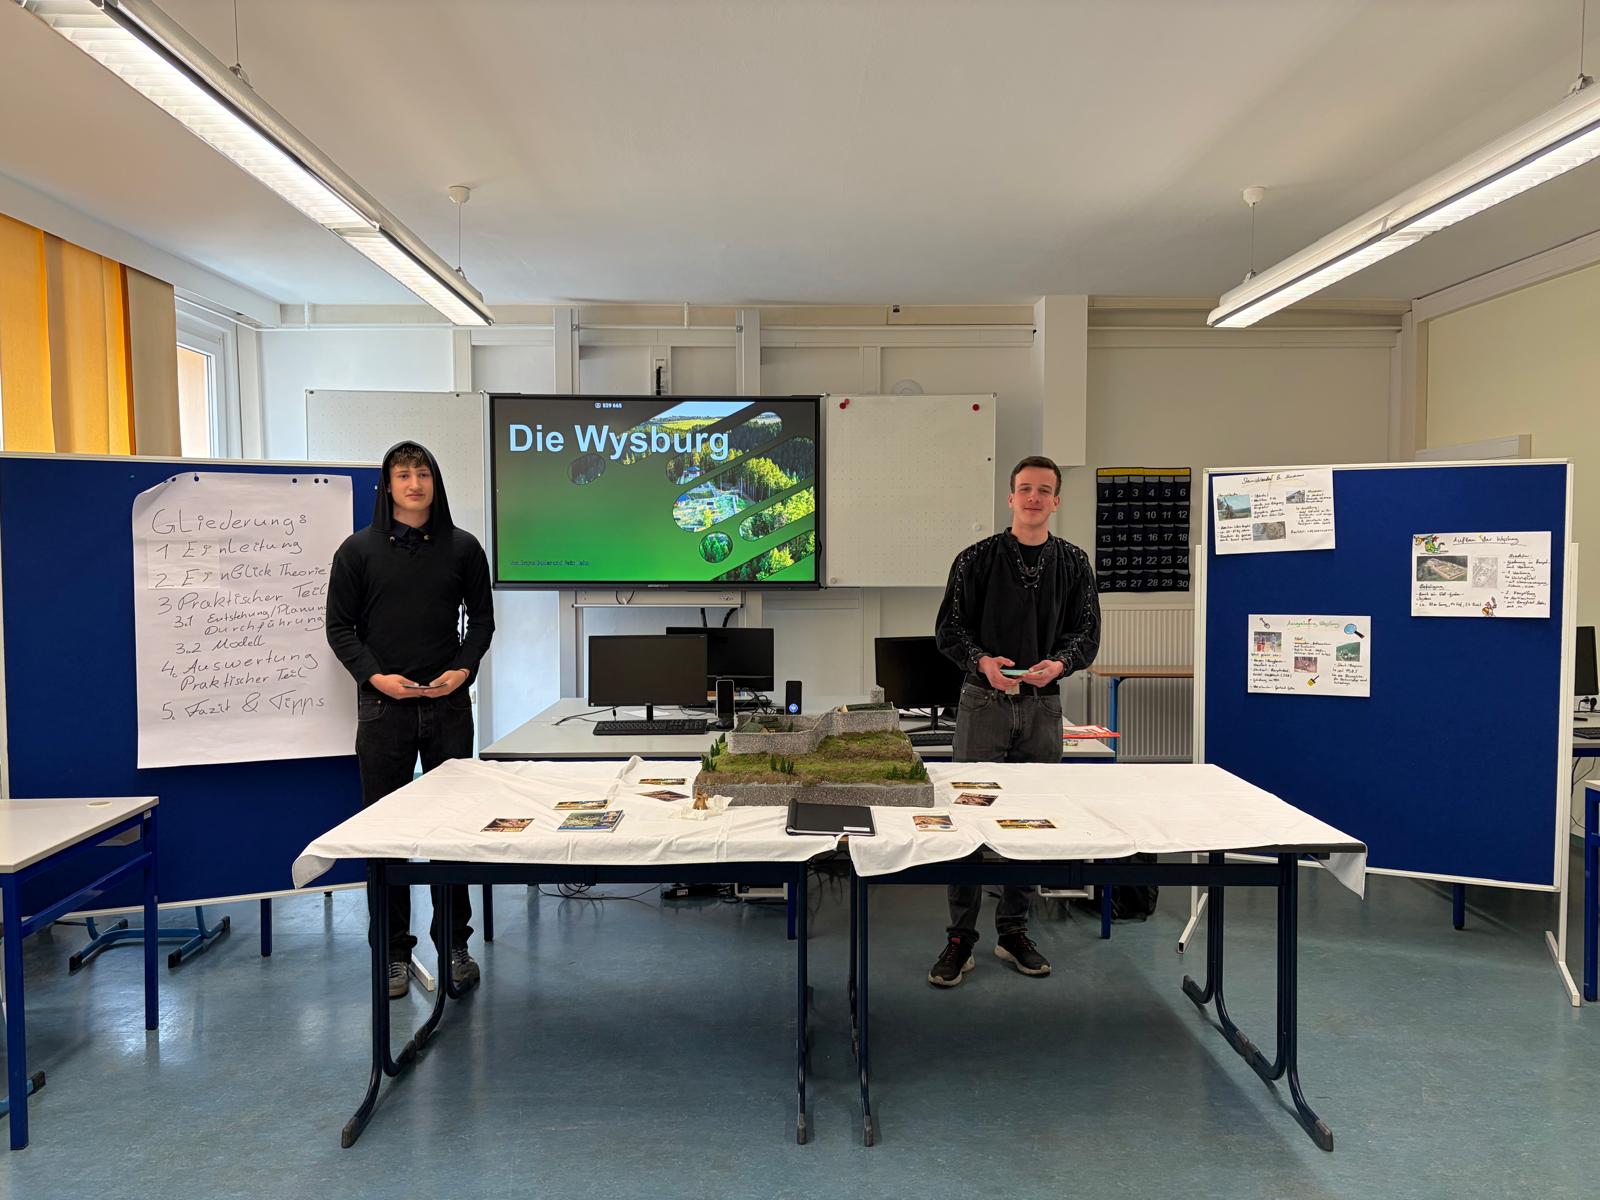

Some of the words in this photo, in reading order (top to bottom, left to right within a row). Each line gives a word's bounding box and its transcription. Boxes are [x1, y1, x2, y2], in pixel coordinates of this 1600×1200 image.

[509, 424, 565, 452] Die
[575, 424, 730, 461] Wysburg
[1133, 489, 1139, 497] 3
[1165, 489, 1171, 497] 5
[1180, 488, 1186, 496] 6
[1118, 512, 1124, 520] 8
[1134, 511, 1140, 519] 9
[1146, 511, 1156, 519] 10
[1102, 535, 1111, 543] 13
[1102, 558, 1111, 566] 19
[1116, 557, 1127, 565] 20
[1132, 557, 1142, 565] 21
[1161, 556, 1172, 564] 23
[1177, 556, 1188, 564] 24
[279, 563, 328, 577] Theorie
[1100, 581, 1110, 589] 25
[1177, 580, 1188, 588] 30
[158, 596, 172, 615] 3
[177, 592, 284, 611] Praktischer
[292, 581, 327, 599] Teil
[173, 616, 193, 629] 3.1
[204, 616, 325, 636] Durchführung
[175, 643, 201, 654] 3.2
[211, 635, 265, 651] Modell
[183, 650, 319, 674] Auswertung
[181, 672, 270, 691] Praktischer
[276, 667, 307, 680] Teil
[185, 698, 231, 718] Fazit
[241, 691, 261, 713] &
[269, 690, 325, 715] Tipps
